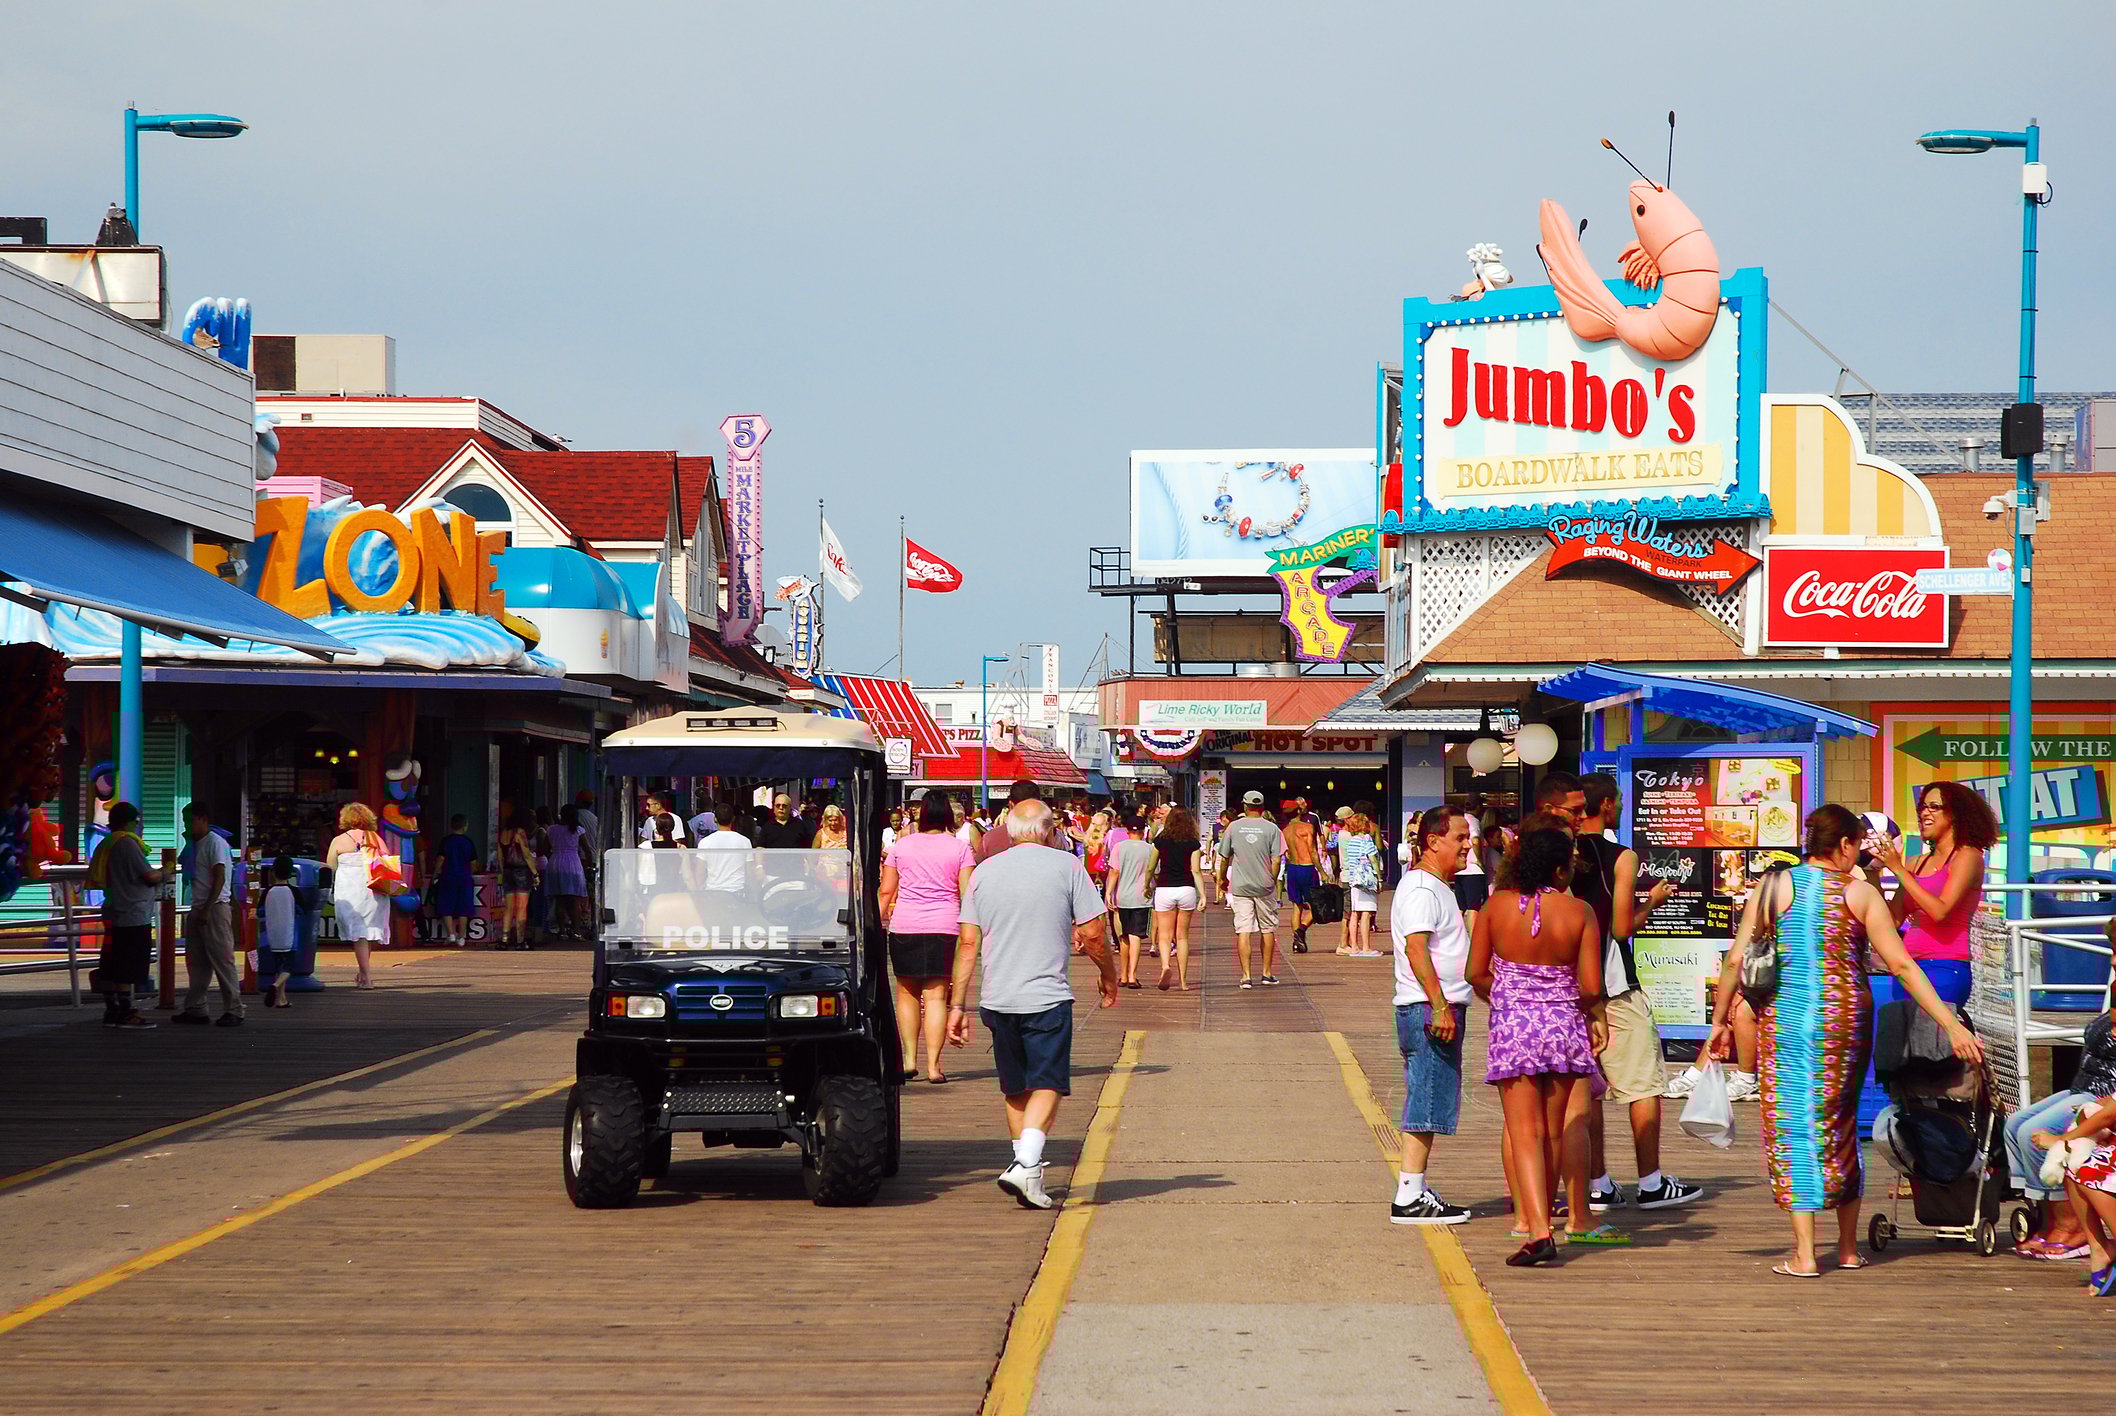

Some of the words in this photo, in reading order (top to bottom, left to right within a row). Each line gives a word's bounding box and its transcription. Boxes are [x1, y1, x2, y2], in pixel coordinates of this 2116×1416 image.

[1443, 346, 1696, 443] Jumbo's
[733, 418, 757, 449] 5
[735, 465, 753, 474] MILE
[1456, 453, 1625, 489] BOARDWALK
[1633, 449, 1703, 479] EATS
[735, 474, 753, 620] MARKETPLACE
[1279, 527, 1376, 567] MARINER'
[1549, 515, 1626, 546] Raging
[1624, 510, 1708, 559] Waters
[255, 496, 507, 619] ZONE
[1583, 546, 1628, 562] BEYOND
[1630, 554, 1652, 572] THE
[1656, 567, 1692, 580] GIANT
[1694, 570, 1733, 580] WHEEL
[1646, 549, 1703, 568] WATERPARK
[1919, 573, 1986, 590] SCHELLENGER
[1989, 572, 2008, 587] AVE
[1783, 570, 1928, 619] Coca-Cola
[1291, 570, 1337, 658] ARCADE
[1158, 703, 1185, 715] Lime
[1188, 703, 1221, 717] Ricky
[1224, 702, 1263, 715] World
[958, 728, 988, 741] PIZZ
[1205, 731, 1254, 752] ORIGINAL
[1253, 733, 1308, 752] HOT
[1312, 733, 1378, 752] SPOT
[1944, 741, 2053, 758] FOLLW
[2059, 741, 2112, 757] THE
[1635, 769, 1704, 792] Tokyo
[1638, 807, 1650, 815] Eat
[1650, 807, 1659, 815] In
[1668, 807, 1687, 815] Take
[1687, 807, 1702, 815] Out
[662, 925, 790, 950] POLICE
[1637, 950, 1698, 969] Murasaki
